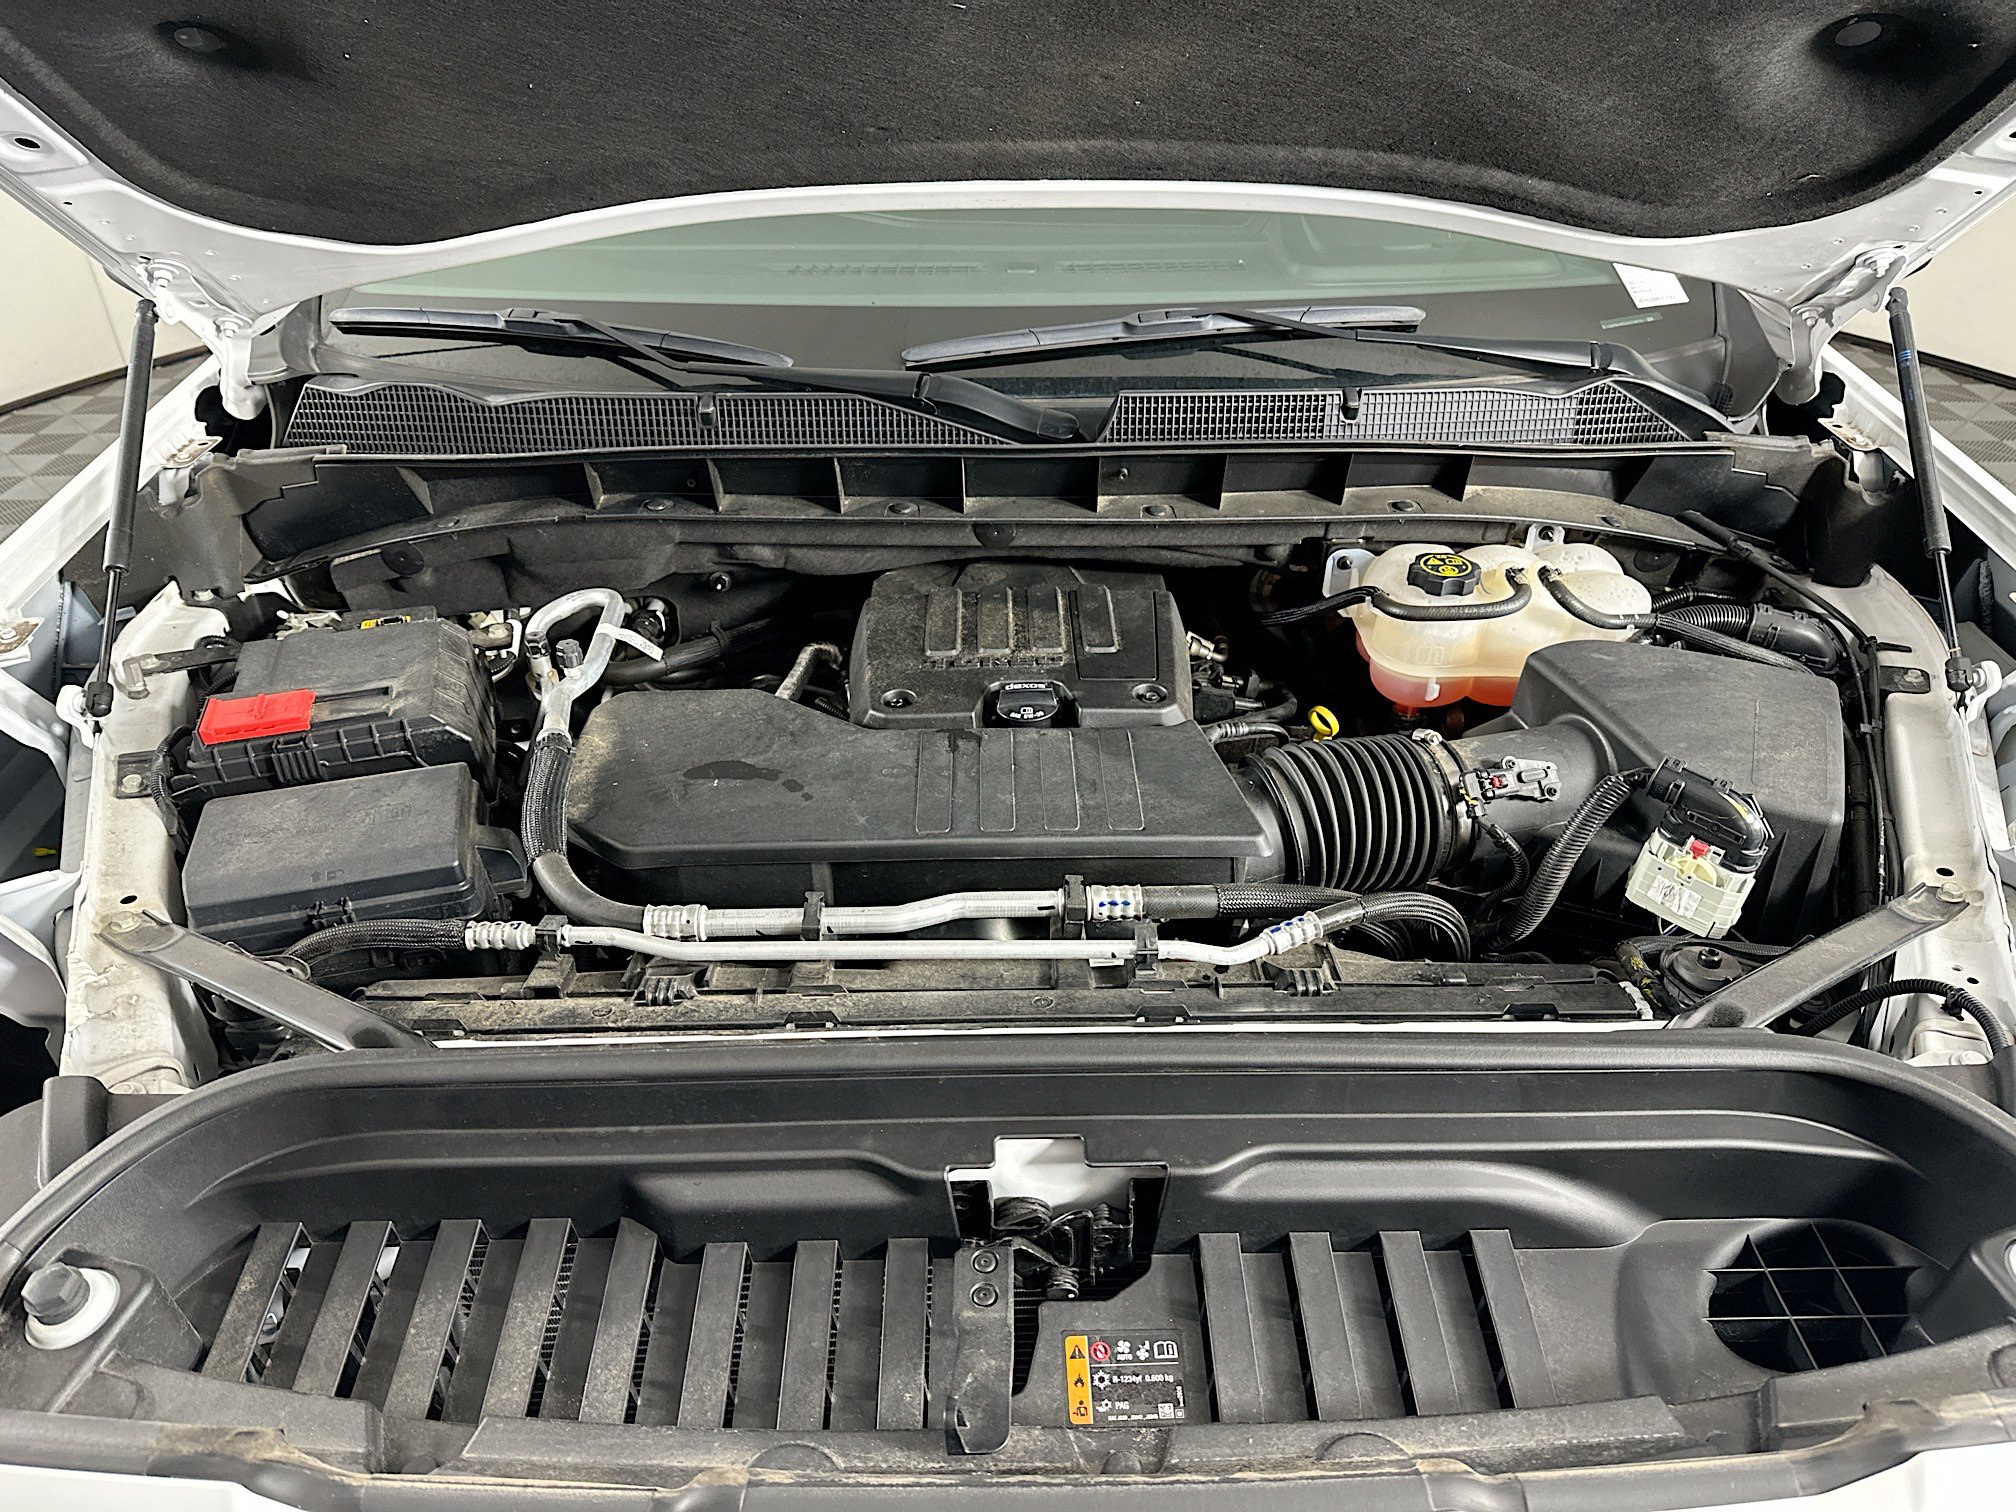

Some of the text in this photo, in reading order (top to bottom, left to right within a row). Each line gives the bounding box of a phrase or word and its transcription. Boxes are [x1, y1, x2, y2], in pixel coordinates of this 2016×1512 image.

[1117, 1353, 1133, 1361] AUTO
[1112, 1374, 1142, 1384] R-1234yf
[1164, 1373, 1174, 1383] kg
[1115, 1401, 1130, 1410] PAG
